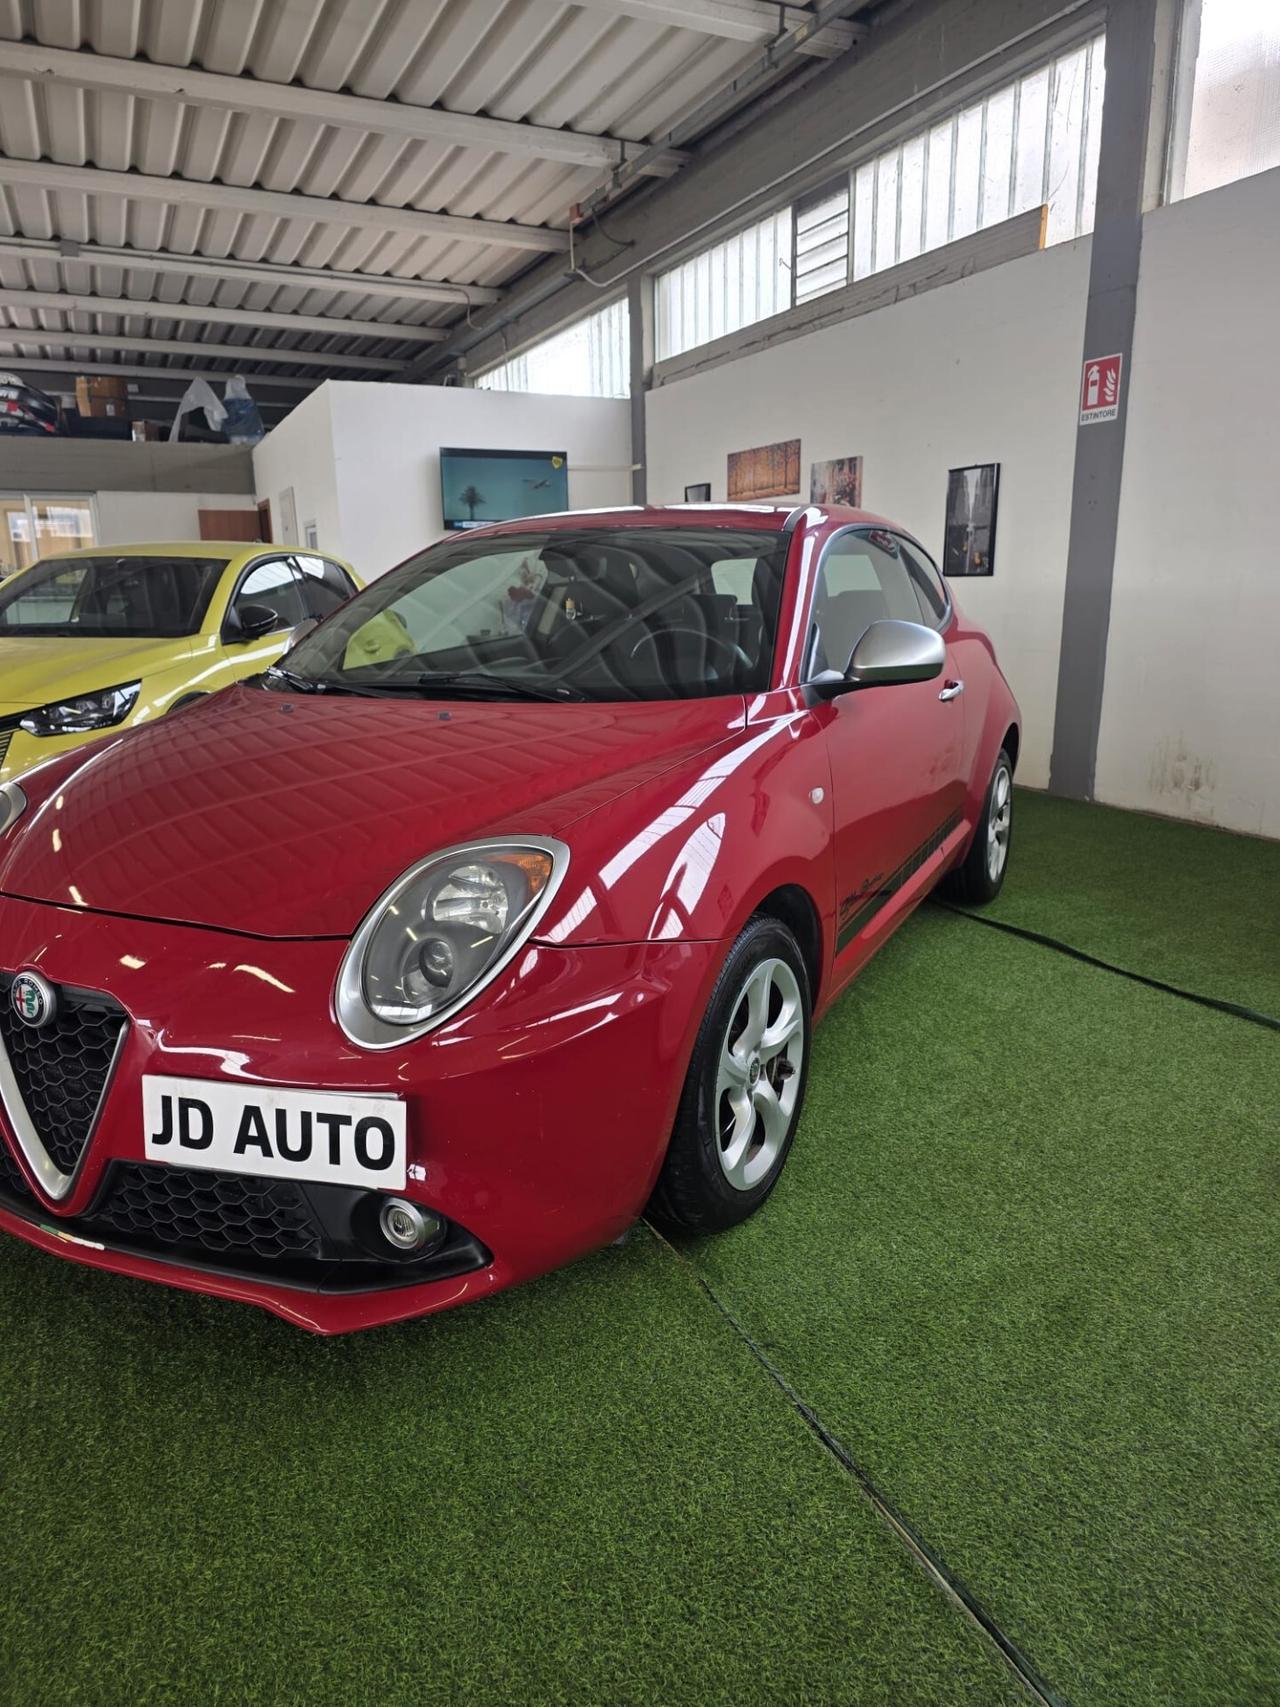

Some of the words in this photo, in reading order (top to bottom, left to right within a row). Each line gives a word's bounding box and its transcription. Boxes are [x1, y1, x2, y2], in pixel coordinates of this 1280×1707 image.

[1081, 409, 1116, 421] ESTINTORE
[151, 1095, 214, 1150] JD
[233, 1105, 395, 1171] AUTO
